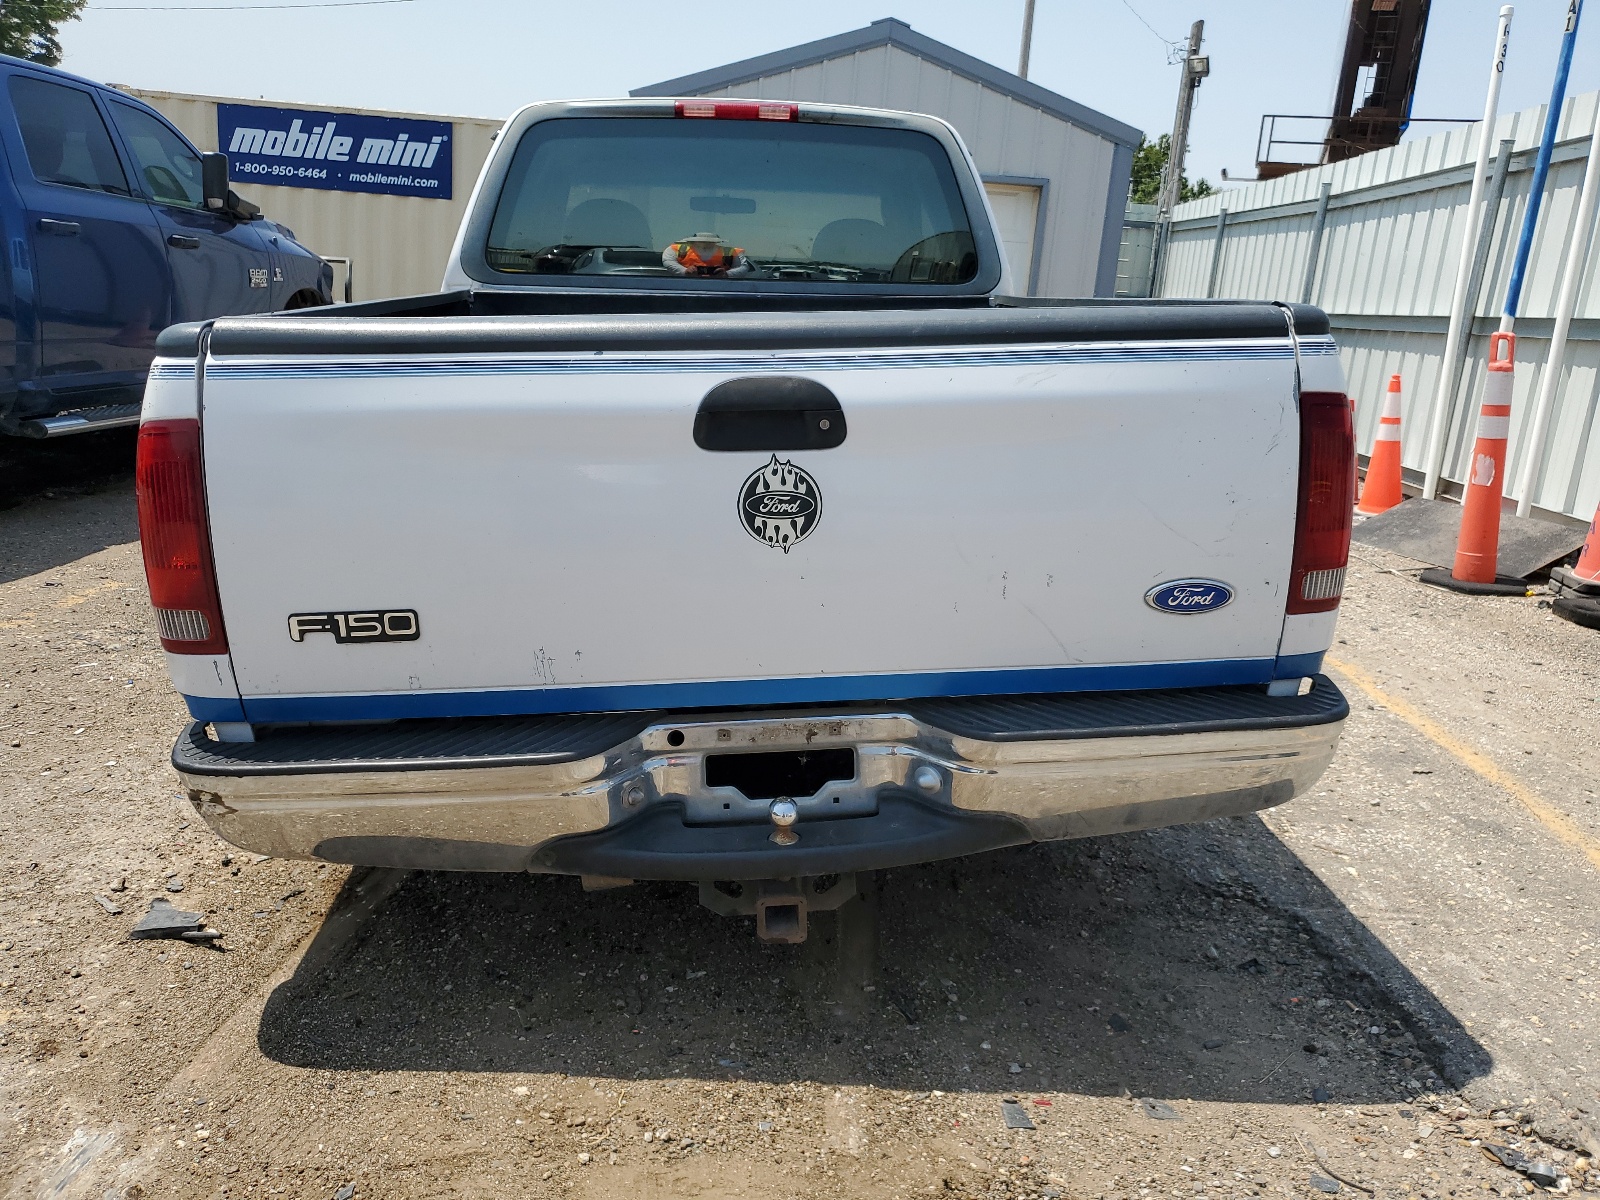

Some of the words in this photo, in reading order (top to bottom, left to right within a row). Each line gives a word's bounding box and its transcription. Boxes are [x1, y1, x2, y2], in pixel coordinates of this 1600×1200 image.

[229, 118, 354, 162] mobile
[356, 133, 441, 168] mini
[235, 161, 328, 180] 1-800-950-6464
[349, 172, 439, 189] mobilemini.com
[759, 495, 800, 513] Ford
[1167, 587, 1216, 606] Ford
[288, 611, 417, 642] F-150
